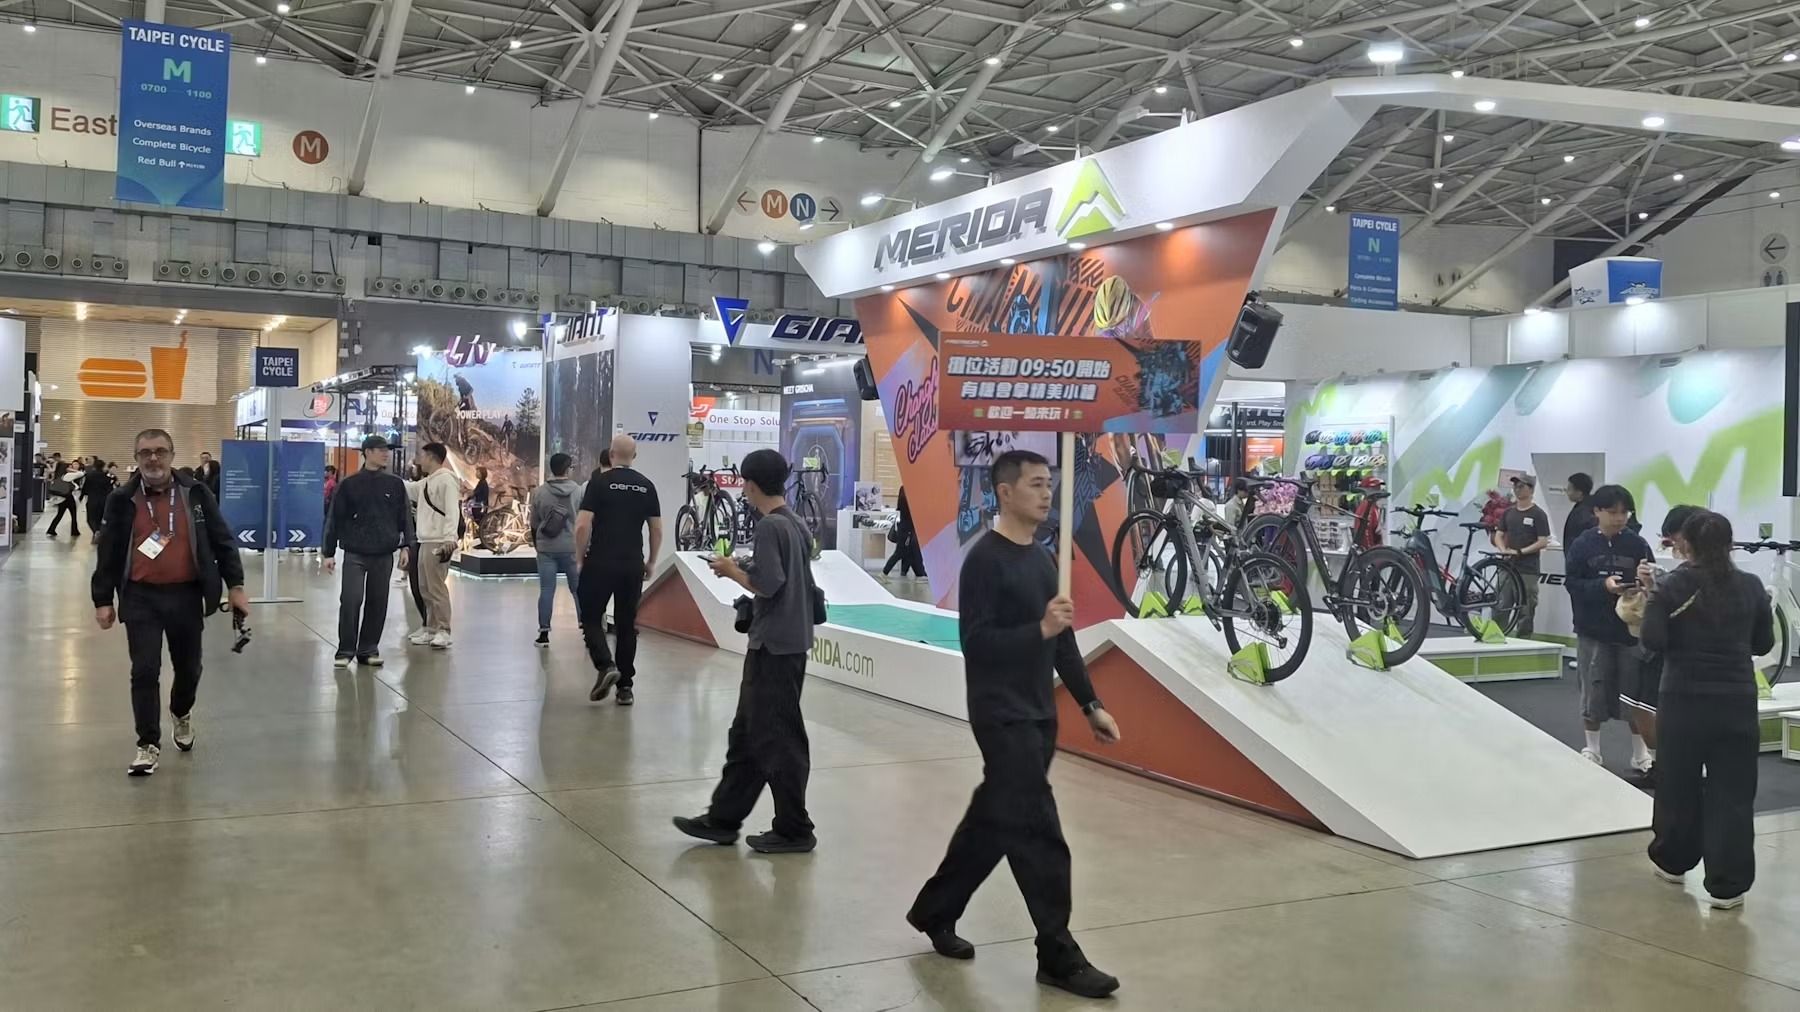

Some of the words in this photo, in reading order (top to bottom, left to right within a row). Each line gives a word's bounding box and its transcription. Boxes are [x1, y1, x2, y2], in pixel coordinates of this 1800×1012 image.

[129, 27, 175, 46] TAIPEI
[179, 34, 225, 53] CYCLE
[163, 58, 192, 83] M
[141, 83, 167, 93] 0700
[186, 89, 212, 99] 1100
[51, 107, 117, 136] East
[133, 119, 177, 132] Overseas
[179, 125, 212, 136] Brands
[132, 137, 177, 150] Complete
[179, 143, 212, 154] Bicycle
[300, 138, 321, 159] M
[137, 156, 156, 165] Red
[159, 158, 176, 168] Bull
[766, 196, 783, 214] M
[795, 198, 810, 216] N
[873, 187, 1054, 271] MERIDA
[1352, 217, 1375, 229] TAIPEI
[1375, 220, 1398, 232] CYCLE
[1368, 237, 1380, 253] N
[771, 314, 866, 345] GIA
[262, 356, 294, 366] TAIPEI
[753, 348, 774, 375] N
[262, 367, 294, 377] CYCLE
[709, 415, 729, 424] One
[733, 415, 756, 426] Stop
[760, 416, 780, 426] Solu
[609, 483, 647, 494] aeroe
[807, 636, 875, 679] RIDA.com
